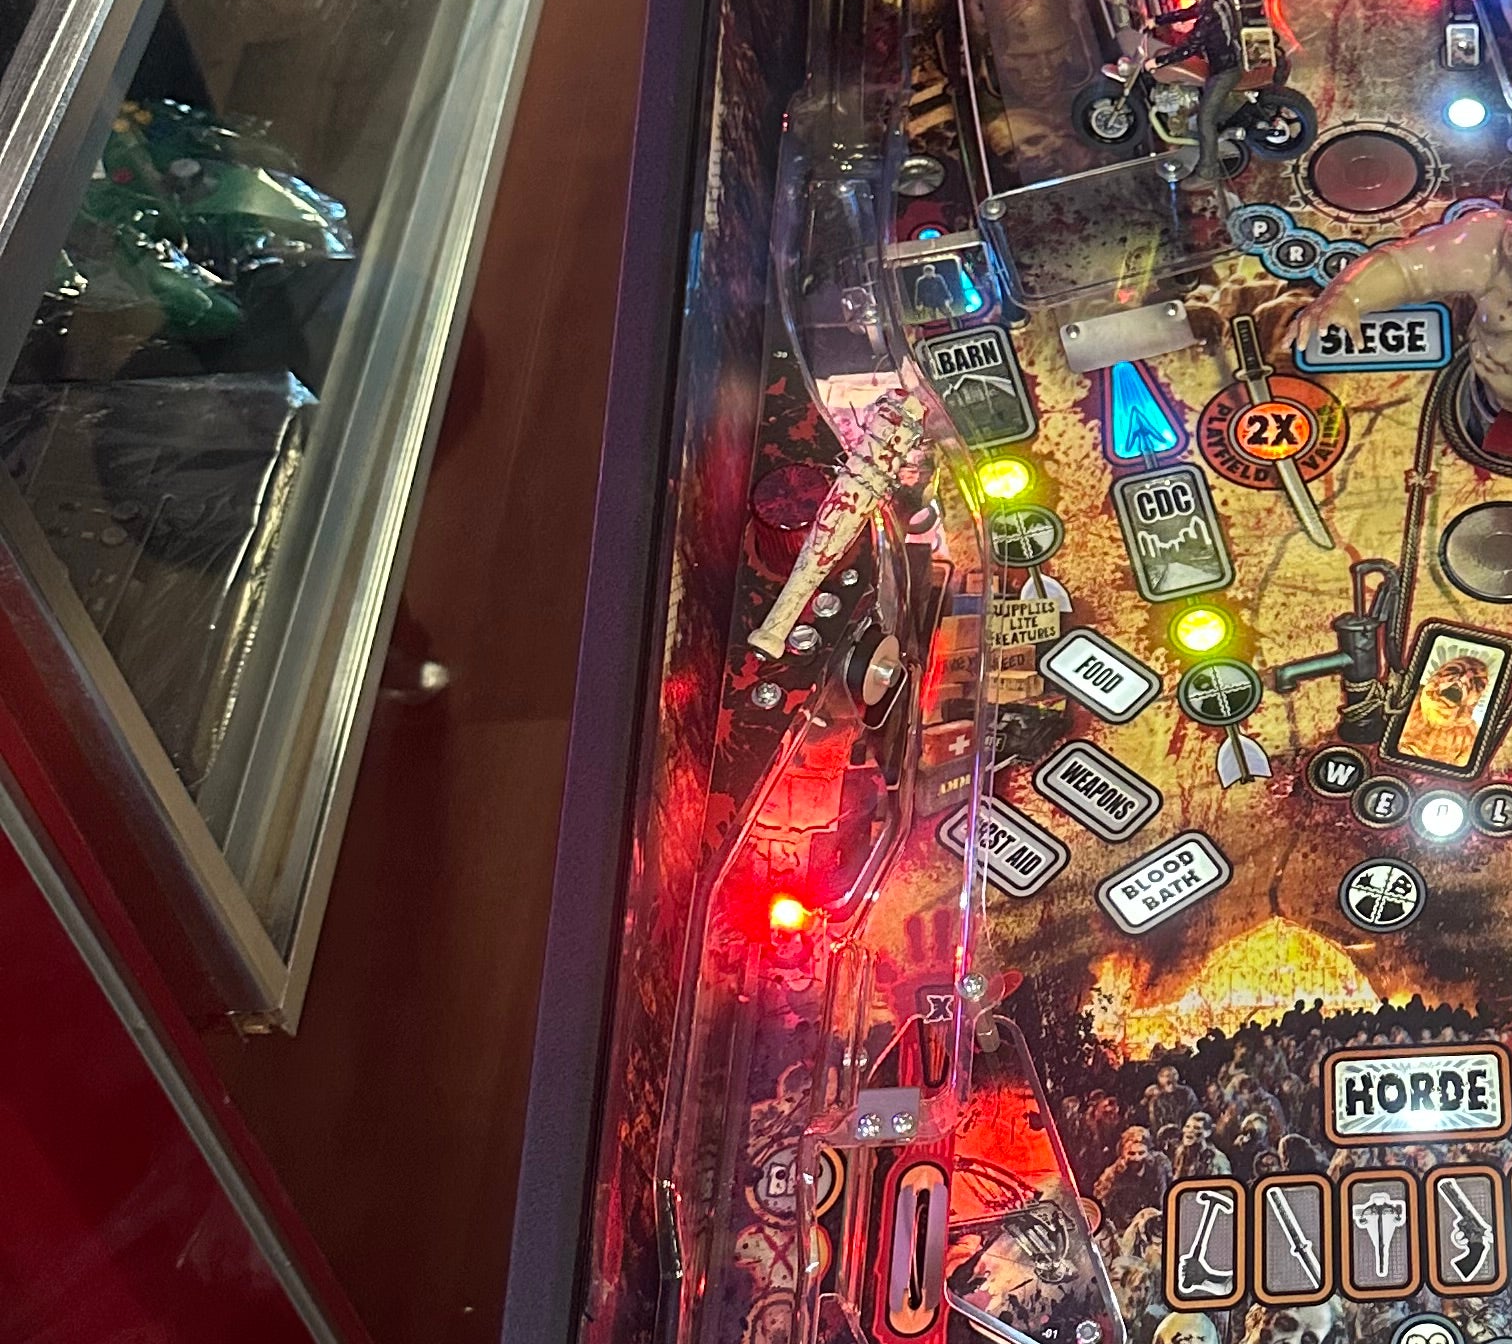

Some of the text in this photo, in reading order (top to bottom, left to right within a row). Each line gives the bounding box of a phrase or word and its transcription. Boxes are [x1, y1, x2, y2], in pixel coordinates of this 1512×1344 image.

[1252, 220, 1268, 238] P
[1289, 245, 1304, 262] R
[938, 340, 1000, 375] BARN
[1247, 413, 1298, 446] 2X
[1136, 484, 1192, 521] CDC
[1010, 616, 1038, 630] LITE
[1072, 655, 1124, 695] FOOD
[1060, 760, 1136, 821] WEAPONS
[1327, 761, 1355, 786] W
[1375, 790, 1395, 815] E
[1006, 844, 1043, 876] AID
[1121, 850, 1195, 900] BLOOD
[1142, 868, 1202, 911] BATH
[1344, 1069, 1489, 1117] HORDE
